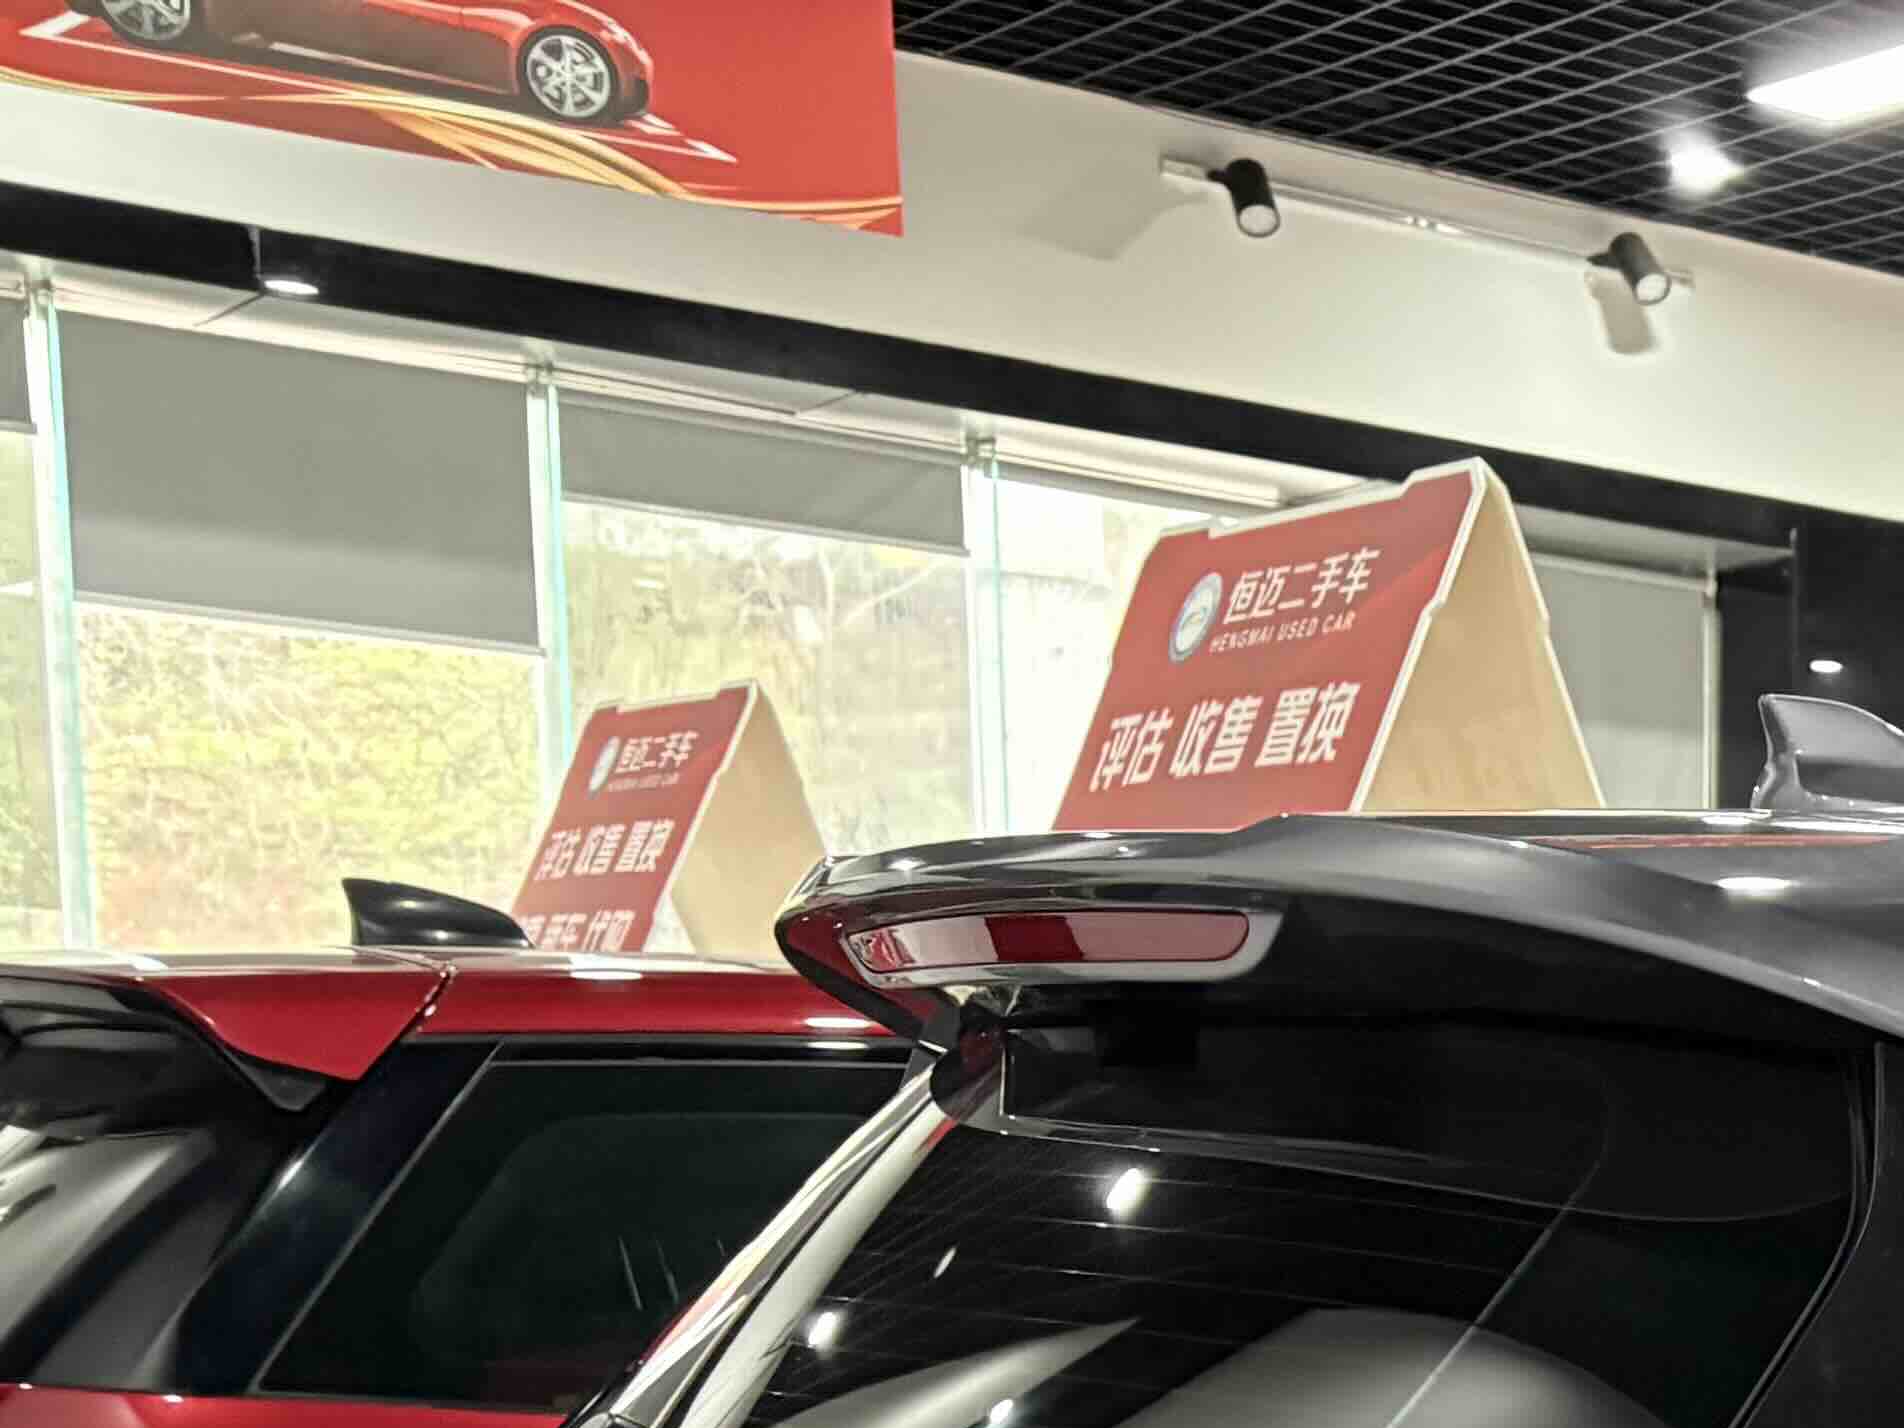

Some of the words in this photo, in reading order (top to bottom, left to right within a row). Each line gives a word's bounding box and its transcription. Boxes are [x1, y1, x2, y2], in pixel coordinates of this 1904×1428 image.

[1222, 547, 1380, 624] 恒迈二手车
[1209, 630, 1274, 653] HENGMAI
[1277, 617, 1317, 641] USED
[1322, 612, 1355, 634] CAR
[1089, 706, 1174, 793] 评估
[1168, 694, 1264, 780] 收售
[1254, 680, 1361, 768] 置换
